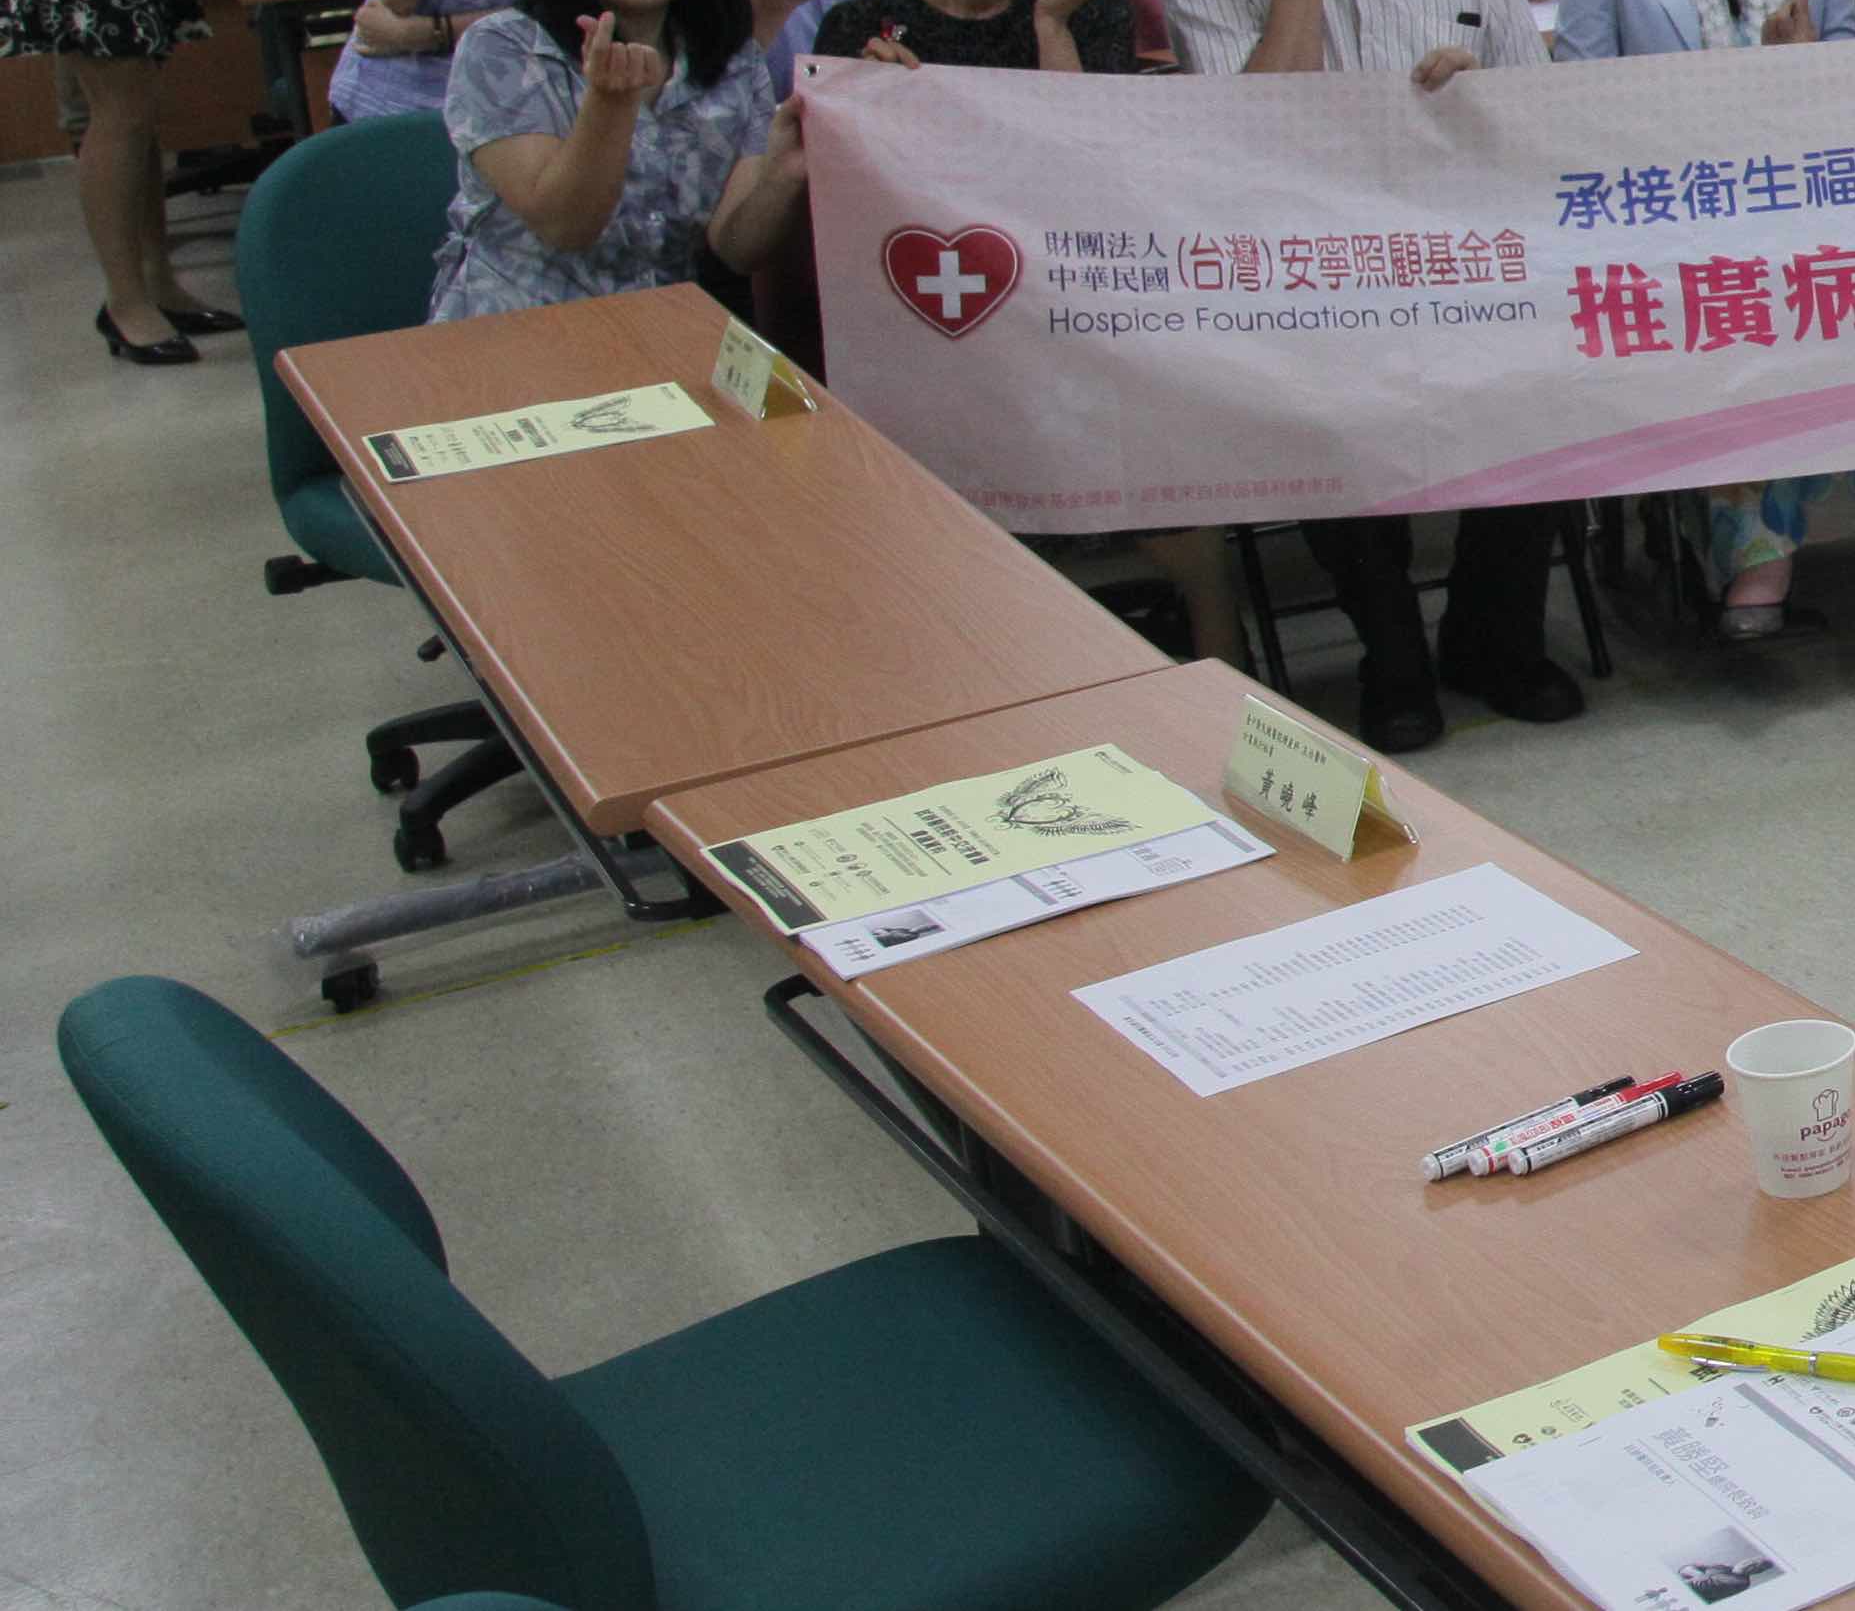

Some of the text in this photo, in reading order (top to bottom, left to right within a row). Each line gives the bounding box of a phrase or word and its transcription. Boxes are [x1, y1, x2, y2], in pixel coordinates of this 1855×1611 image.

[1044, 231, 1168, 260] 財團法人
[1047, 264, 1170, 293] 中華民國
[1048, 297, 1538, 338] Hospice Foundation of Taiwan
